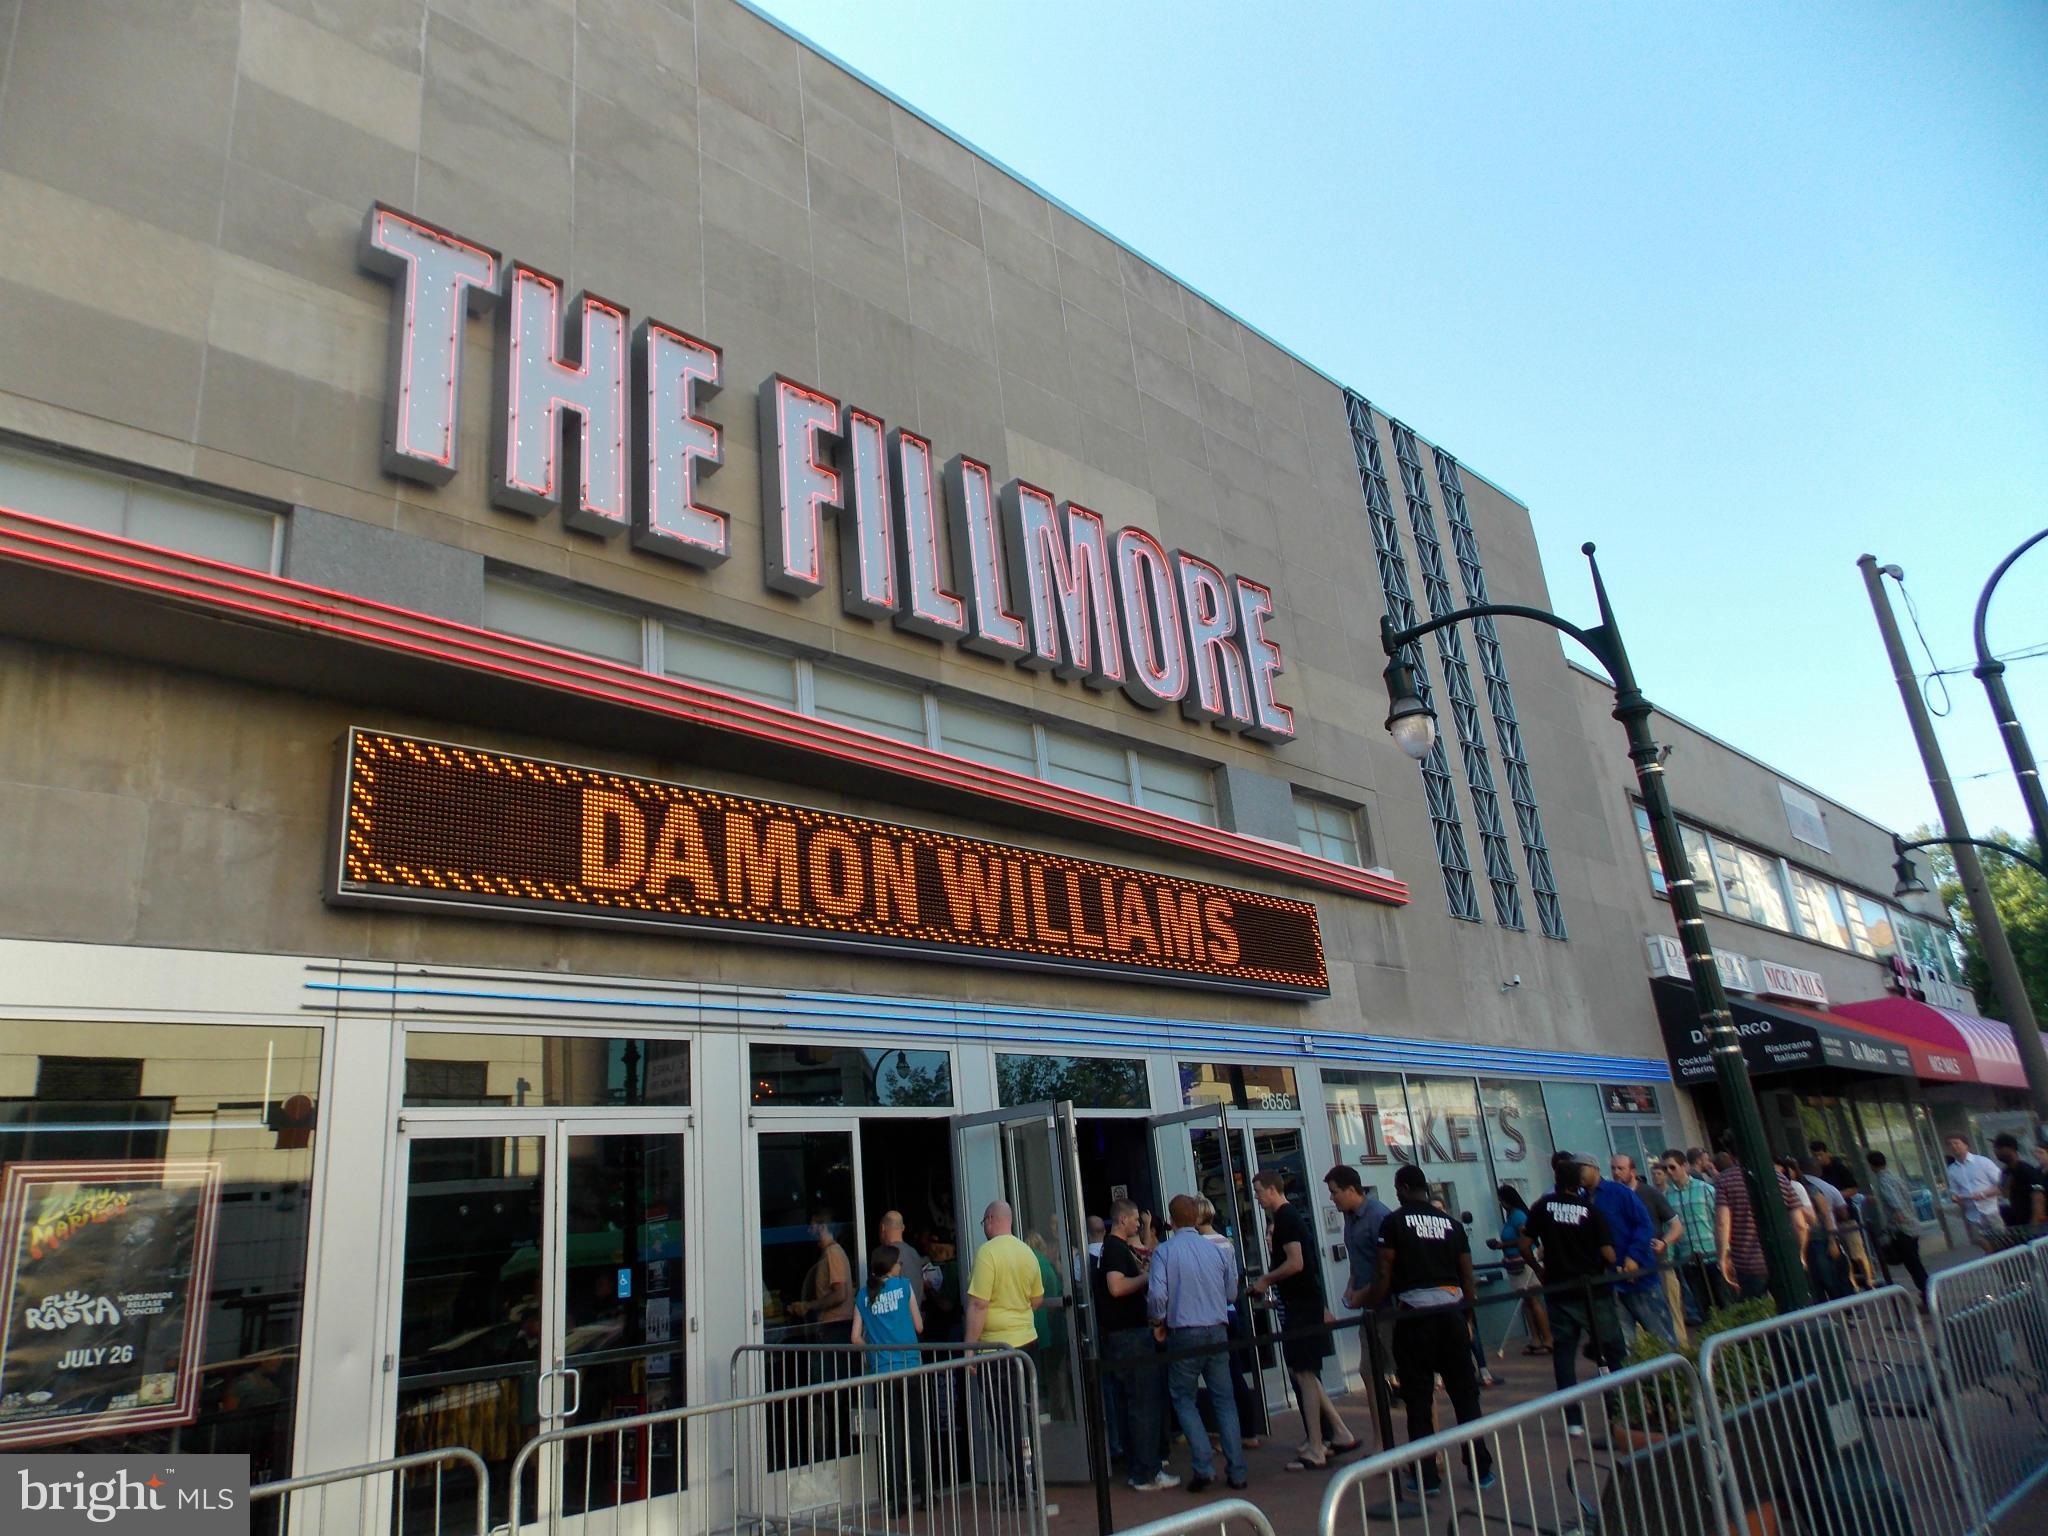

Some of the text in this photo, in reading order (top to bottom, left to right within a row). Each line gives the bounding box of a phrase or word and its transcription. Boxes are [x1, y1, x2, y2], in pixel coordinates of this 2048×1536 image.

[363, 200, 1296, 745] THE FILLMORE
[581, 787, 1242, 967] DAMON WILLIAMS
[1764, 966, 1791, 991] NICE
[1790, 970, 1825, 998] NAILS
[1690, 1020, 1772, 1044] D ARCO
[1764, 1039, 1813, 1054] Ristorante
[1773, 1050, 1809, 1063] Italiano
[1260, 1092, 1292, 1110] 8656
[1404, 1214, 1454, 1232] FILLMORE
[1553, 1211, 1580, 1225] CREW
[1415, 1225, 1446, 1240] CREW
[118, 1291, 174, 1303] WORLDWIDE
[126, 1299, 163, 1308] RELEASE
[25, 1296, 121, 1330] RASTA
[123, 1306, 165, 1316] CONCERT
[871, 1300, 899, 1316] CREW
[57, 1344, 134, 1369] JULY 26
